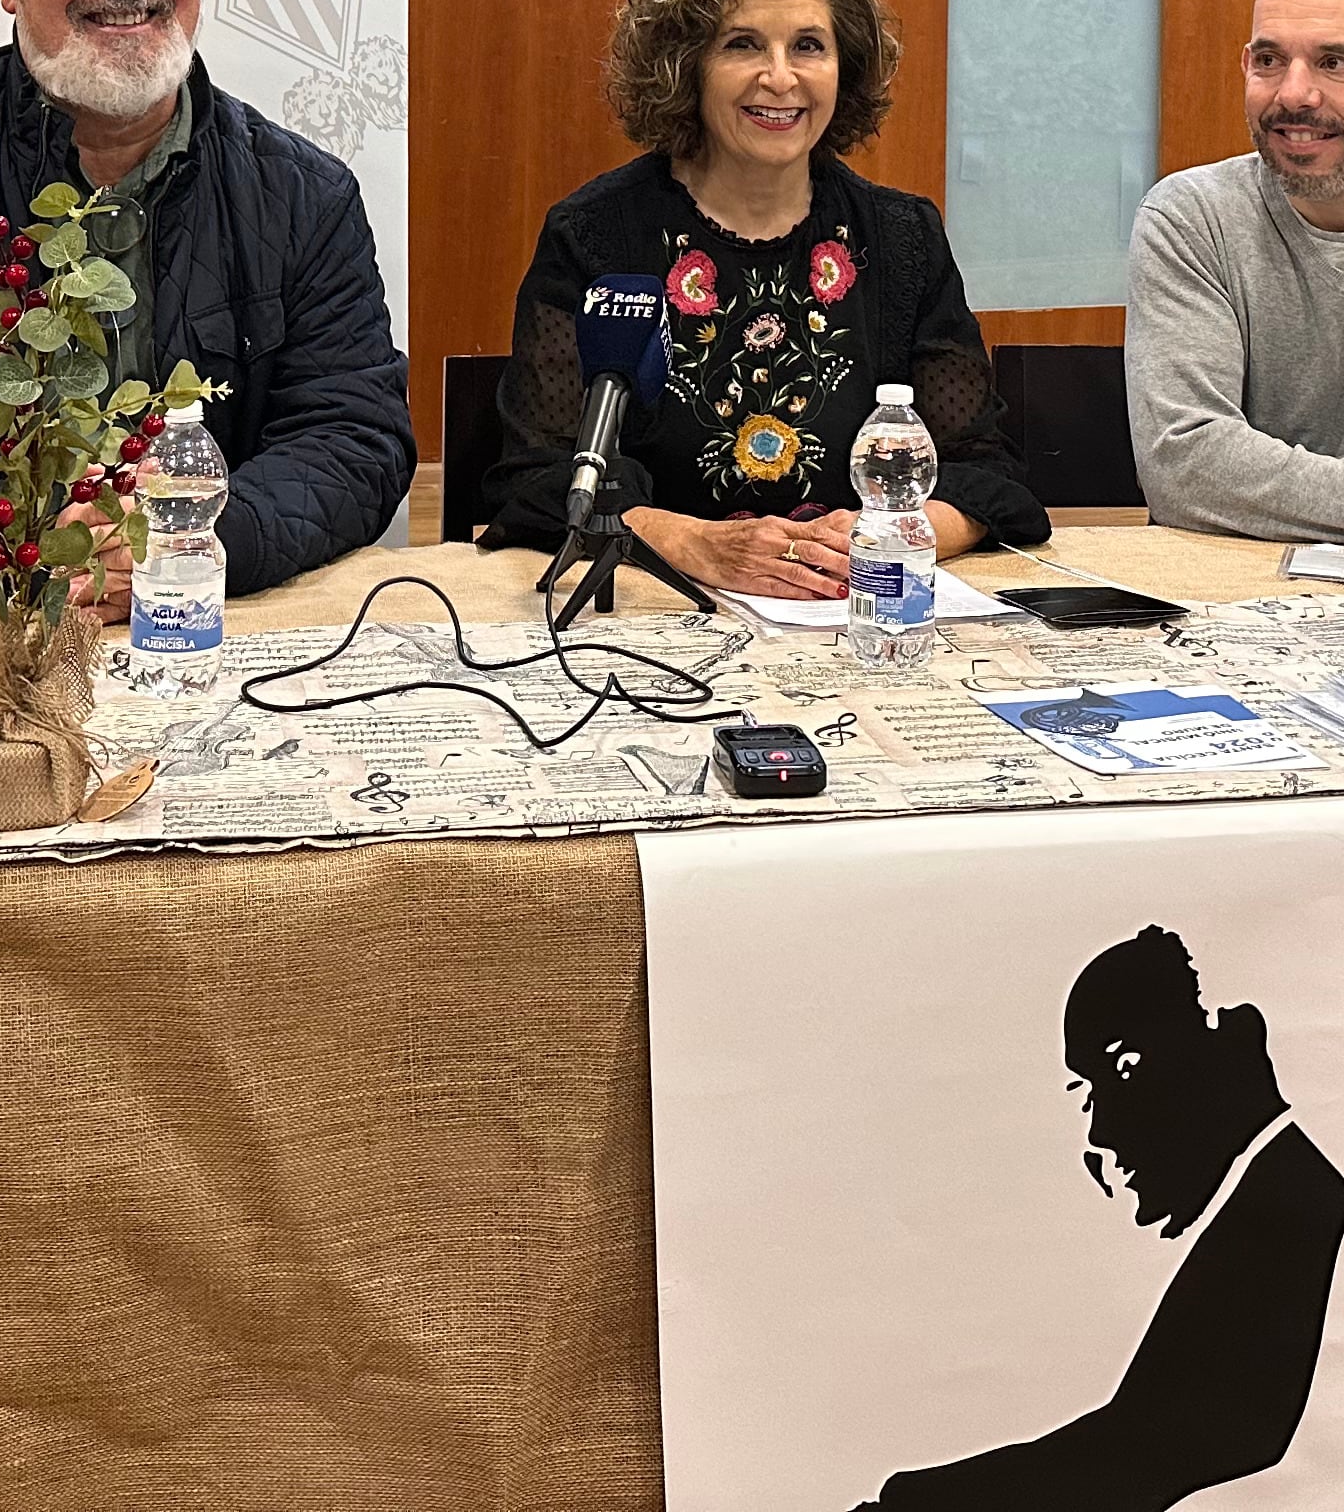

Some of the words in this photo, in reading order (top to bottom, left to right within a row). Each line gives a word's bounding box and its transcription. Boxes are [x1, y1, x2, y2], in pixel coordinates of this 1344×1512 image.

[613, 292, 657, 304] Radio
[152, 609, 186, 619] AGUA
[142, 638, 195, 650] FUENCISLA
